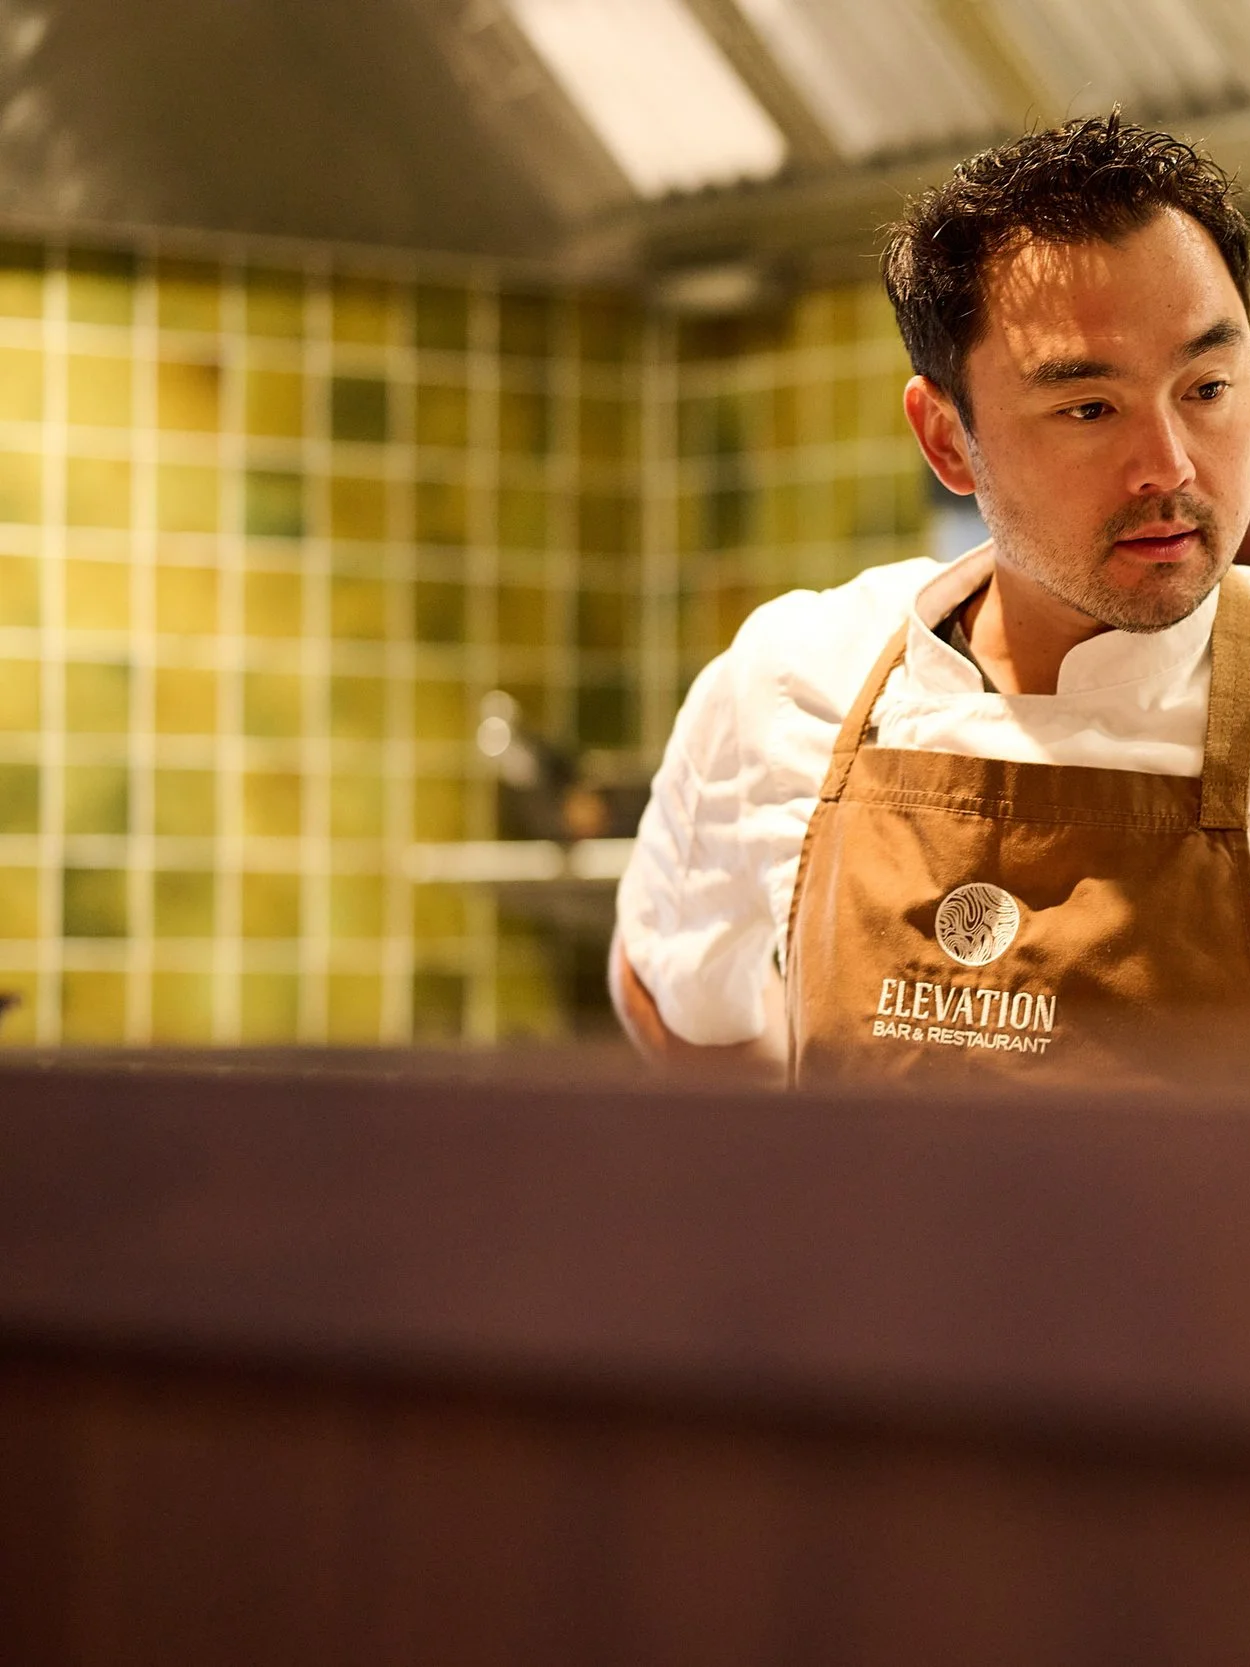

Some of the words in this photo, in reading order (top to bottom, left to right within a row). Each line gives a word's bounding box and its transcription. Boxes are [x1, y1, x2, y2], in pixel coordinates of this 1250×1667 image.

[877, 978, 1056, 1032] ELEVATION
[873, 1020, 911, 1041] BAR
[912, 1028, 924, 1041] &
[927, 1026, 1051, 1054] RESTAURANT
